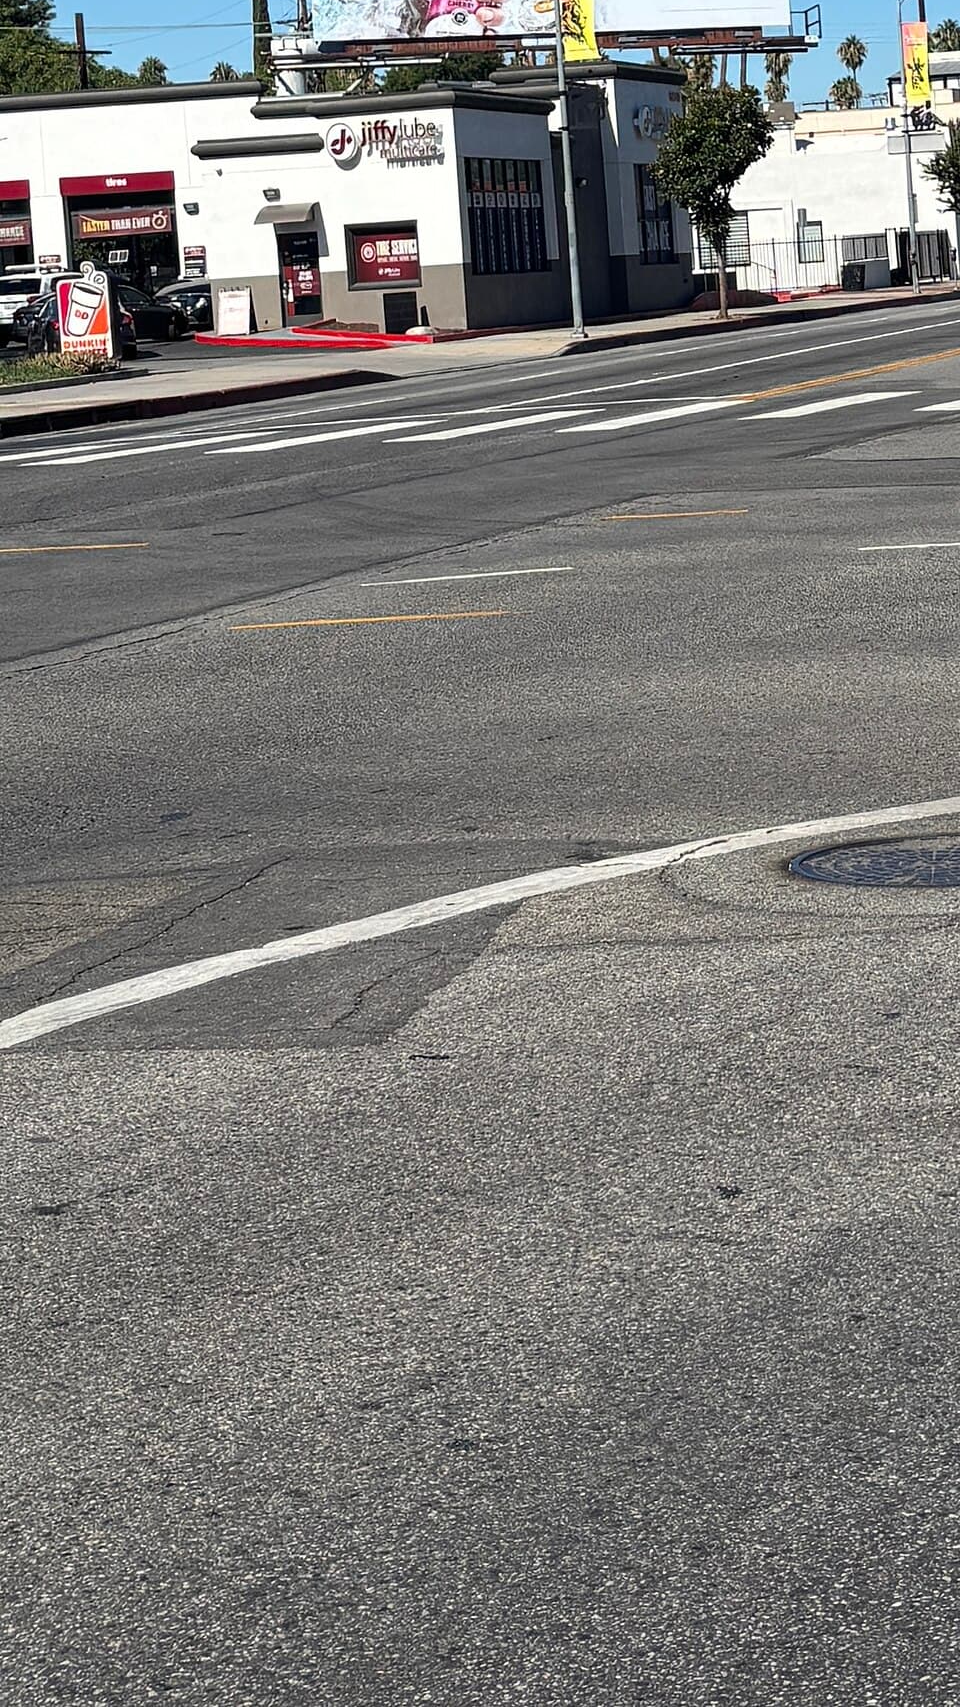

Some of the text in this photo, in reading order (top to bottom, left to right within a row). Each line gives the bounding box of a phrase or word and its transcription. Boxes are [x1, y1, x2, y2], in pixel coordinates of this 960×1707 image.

[361, 117, 436, 147] jiffy lube
[380, 144, 438, 158] multicare
[105, 177, 128, 187] tires
[82, 216, 151, 233] FASTER THAN EVER
